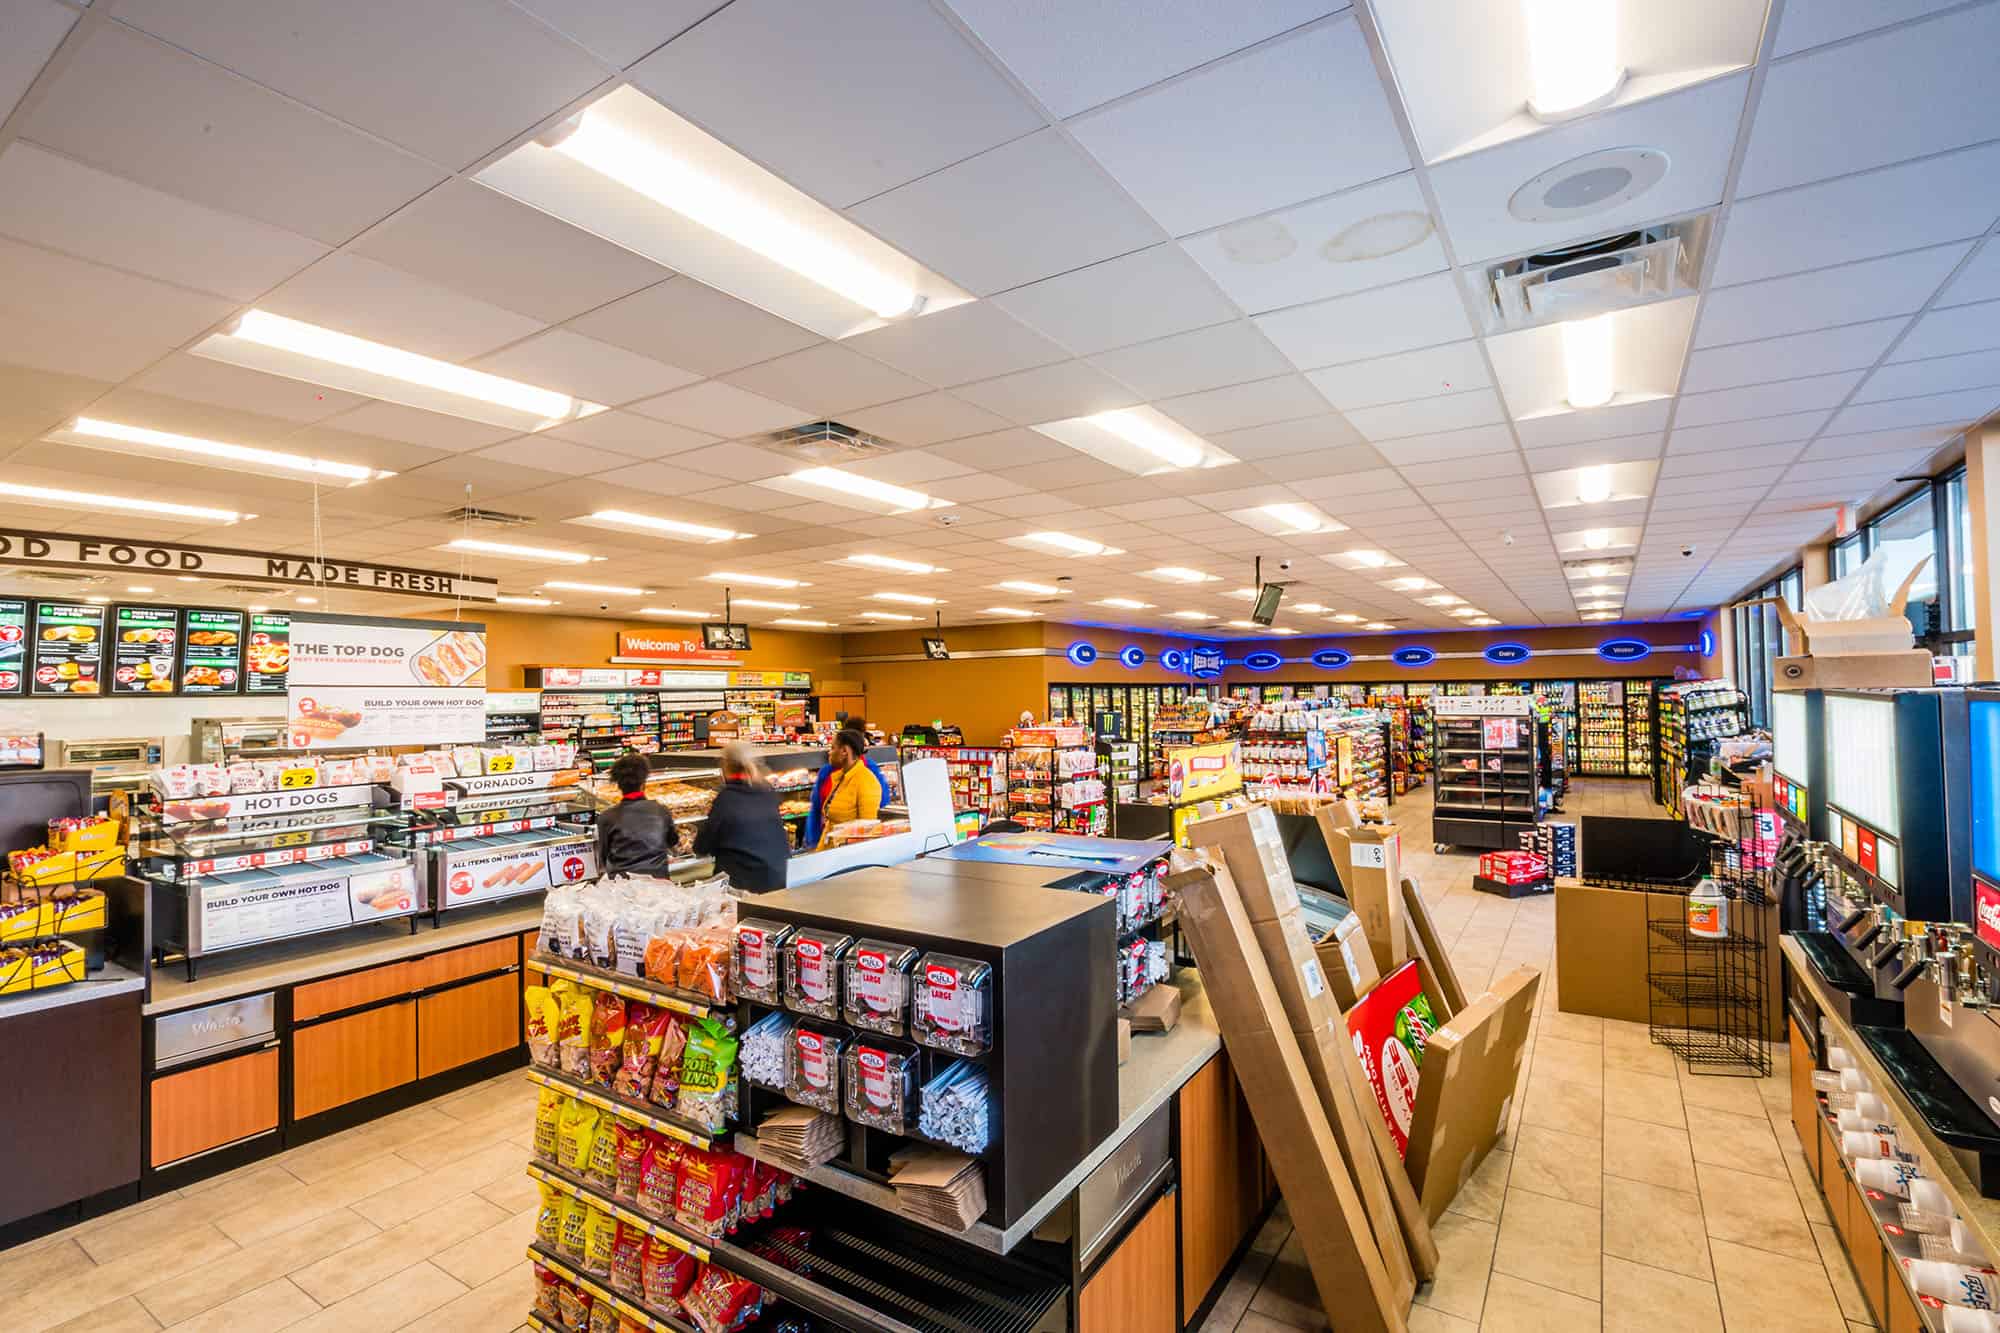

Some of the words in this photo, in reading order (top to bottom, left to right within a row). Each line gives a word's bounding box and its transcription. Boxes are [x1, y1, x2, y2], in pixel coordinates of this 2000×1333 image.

[79, 542, 203, 570] FOOD
[267, 559, 359, 584] MADE
[374, 571, 453, 593] FRESH
[294, 643, 329, 655] THE
[333, 645, 366, 656] TOP
[370, 646, 405, 657] DOG
[626, 638, 680, 652] Welcome
[683, 640, 696, 652] To
[284, 776, 294, 786] 2
[465, 776, 535, 790] TORNADOS
[245, 797, 282, 811] HOT
[290, 792, 338, 806] DOGS
[206, 898, 239, 910] BUILD
[240, 893, 269, 905] YOUR
[271, 889, 297, 900] OWN
[298, 885, 319, 896] HOT
[319, 882, 341, 892] DOG
[800, 944, 817, 954] PULL
[862, 957, 880, 967] PULL
[863, 974, 881, 984] LARGE
[931, 973, 951, 984] PULL
[931, 990, 952, 1001] LARGE
[801, 1038, 817, 1048] PULL
[862, 1055, 881, 1066] PULL
[1388, 1040, 1416, 1113] REE
